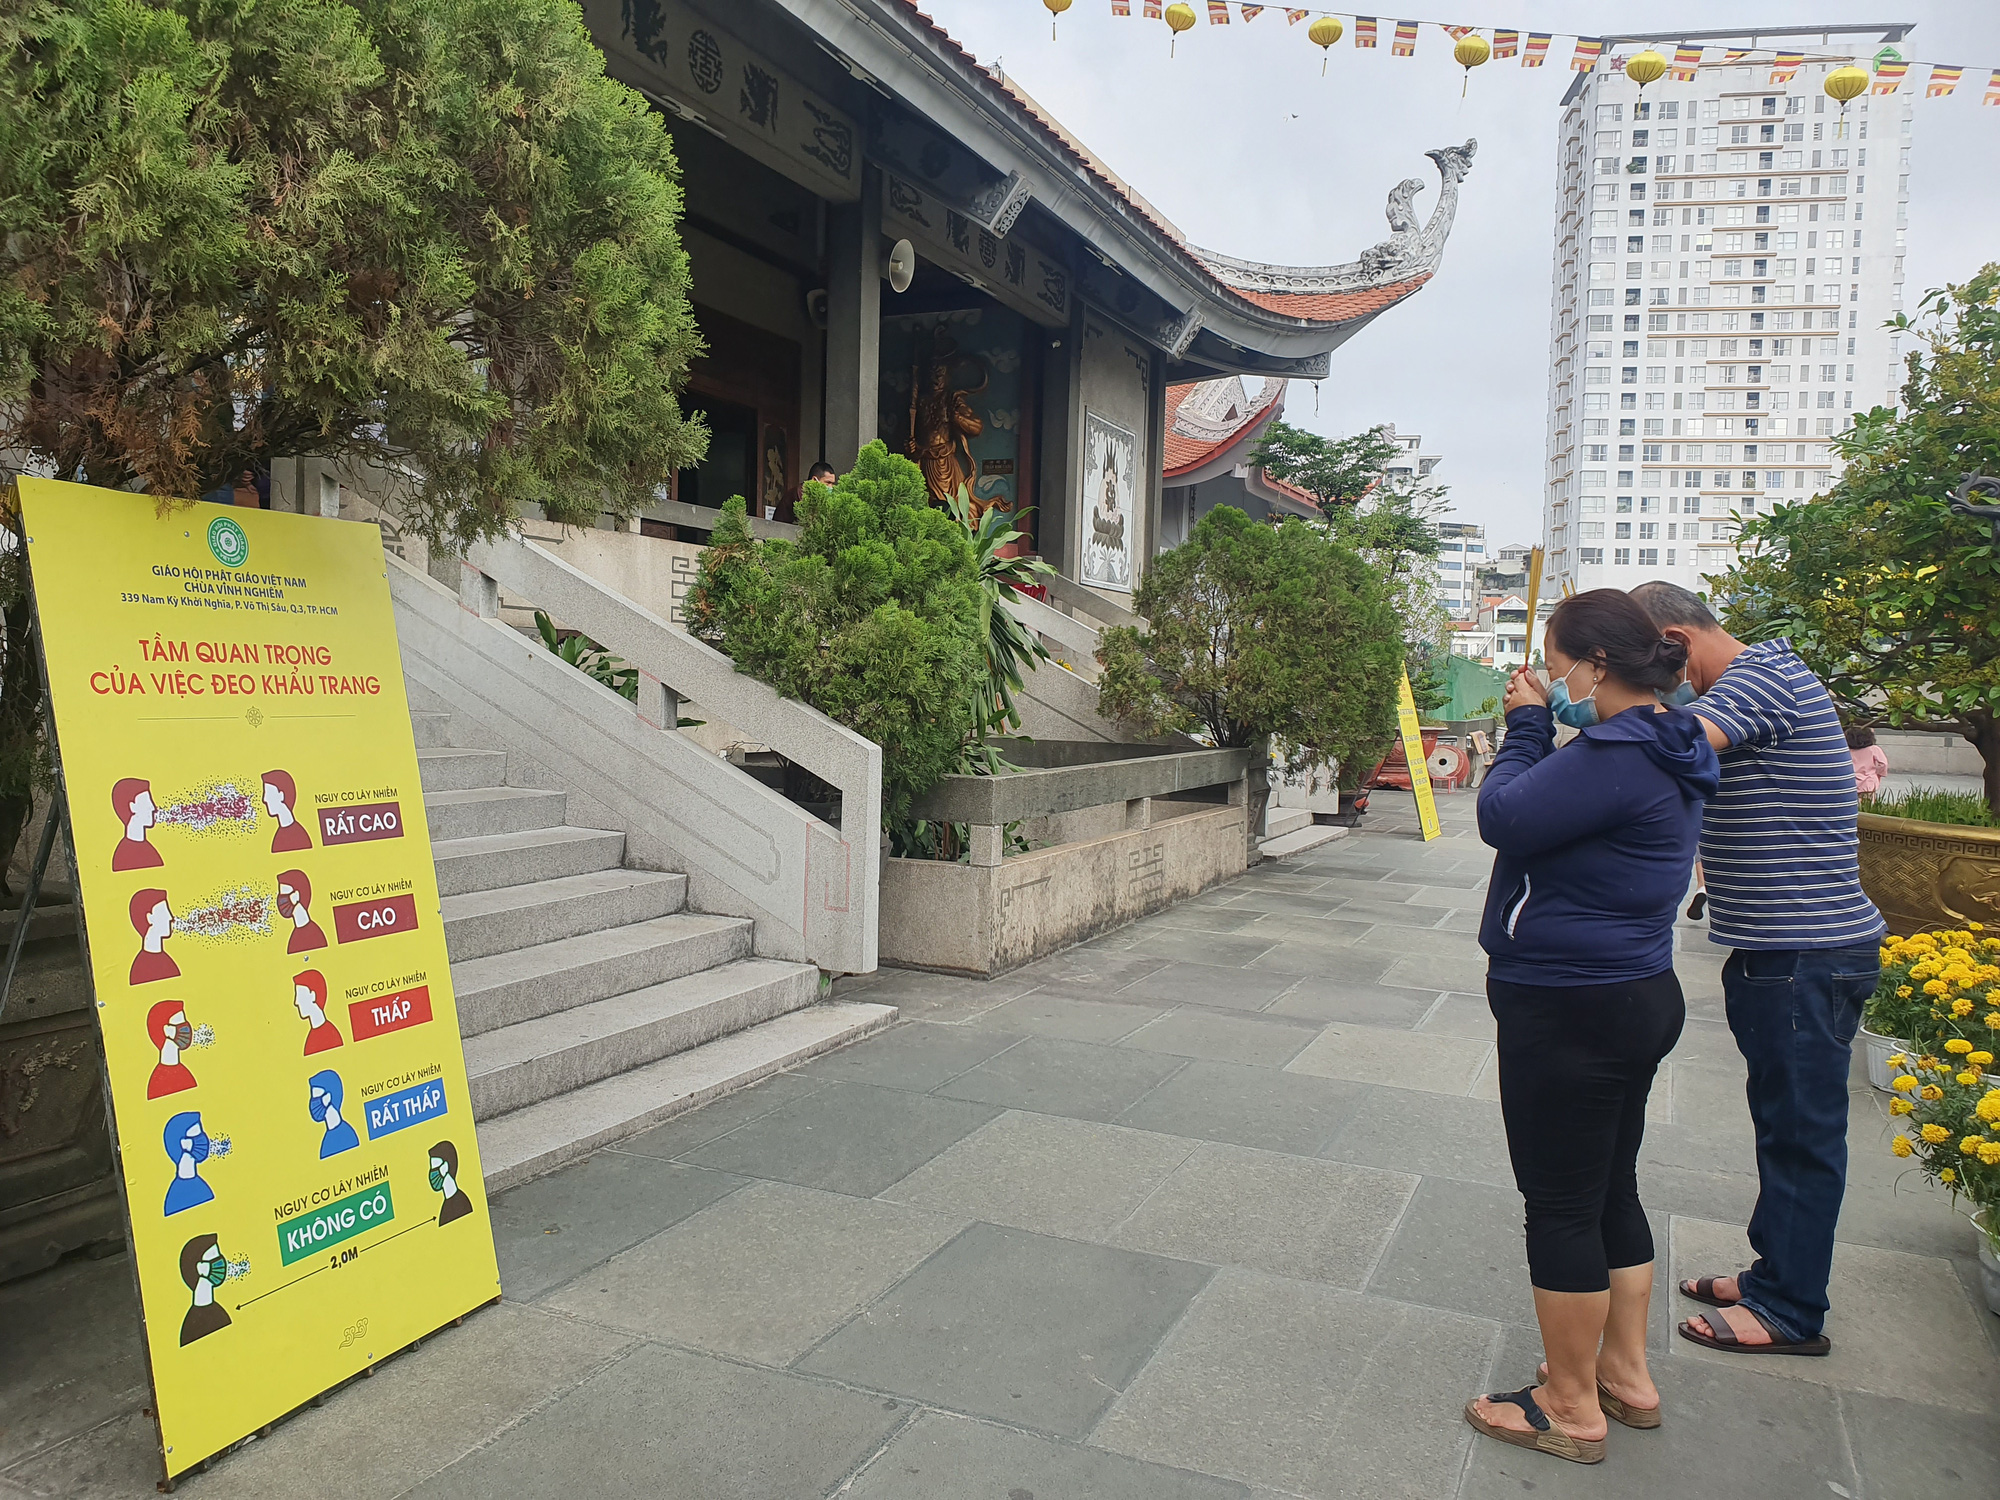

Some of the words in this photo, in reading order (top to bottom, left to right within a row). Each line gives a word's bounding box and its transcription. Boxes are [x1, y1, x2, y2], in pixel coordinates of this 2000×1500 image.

[152, 564, 180, 578] GIÁO
[183, 567, 203, 581] HỘI
[234, 572, 260, 584] GIÁO
[261, 574, 282, 588] VIỆT
[284, 577, 307, 588] NAM
[184, 581, 215, 594] CHÙA
[244, 586, 285, 599] NGHIÊM
[121, 592, 140, 603] 339
[142, 594, 165, 604] Nam
[167, 595, 178, 607] Kỳ
[180, 596, 203, 607] Khởi
[204, 598, 233, 610] Nghĩa,
[235, 600, 243, 610] P.
[243, 601, 255, 610] Võ
[256, 602, 270, 613] Thị
[271, 603, 289, 613] Sáu,
[306, 605, 319, 614] TP.
[320, 606, 339, 616] HCM
[138, 631, 190, 662] TẦM
[196, 641, 260, 663] QUAN
[90, 664, 146, 695] CỦA
[150, 669, 205, 699] VIỆC
[211, 674, 256, 695] ĐEO
[261, 666, 315, 695] KHẨU
[319, 675, 381, 695] TRANG
[314, 793, 339, 803] NGUY
[341, 791, 355, 801] CƠ
[356, 789, 371, 800] LÂY
[325, 810, 355, 836] RẤT
[359, 812, 397, 832] CAO
[330, 889, 354, 901] NGUY
[356, 886, 370, 897] CƠ
[371, 883, 386, 894] LÂY
[357, 907, 396, 930] CAO
[345, 985, 369, 999] NGUY
[371, 981, 385, 992] CƠ
[386, 977, 401, 989] LÂY
[371, 996, 411, 1026] THẤP
[361, 1081, 385, 1097] NGUY
[386, 1076, 400, 1088] CƠ
[401, 1072, 416, 1084] LÂY
[371, 1098, 400, 1129] RẤT
[403, 1085, 441, 1117] THẤP
[274, 1196, 308, 1220] NGUY
[311, 1186, 331, 1204] CƠ
[333, 1178, 353, 1197] LÂY
[355, 1164, 389, 1188] NHIỄM
[287, 1208, 356, 1253] KHÔNG
[359, 1190, 387, 1220] CÓ
[330, 1246, 359, 1269] 2,0M
